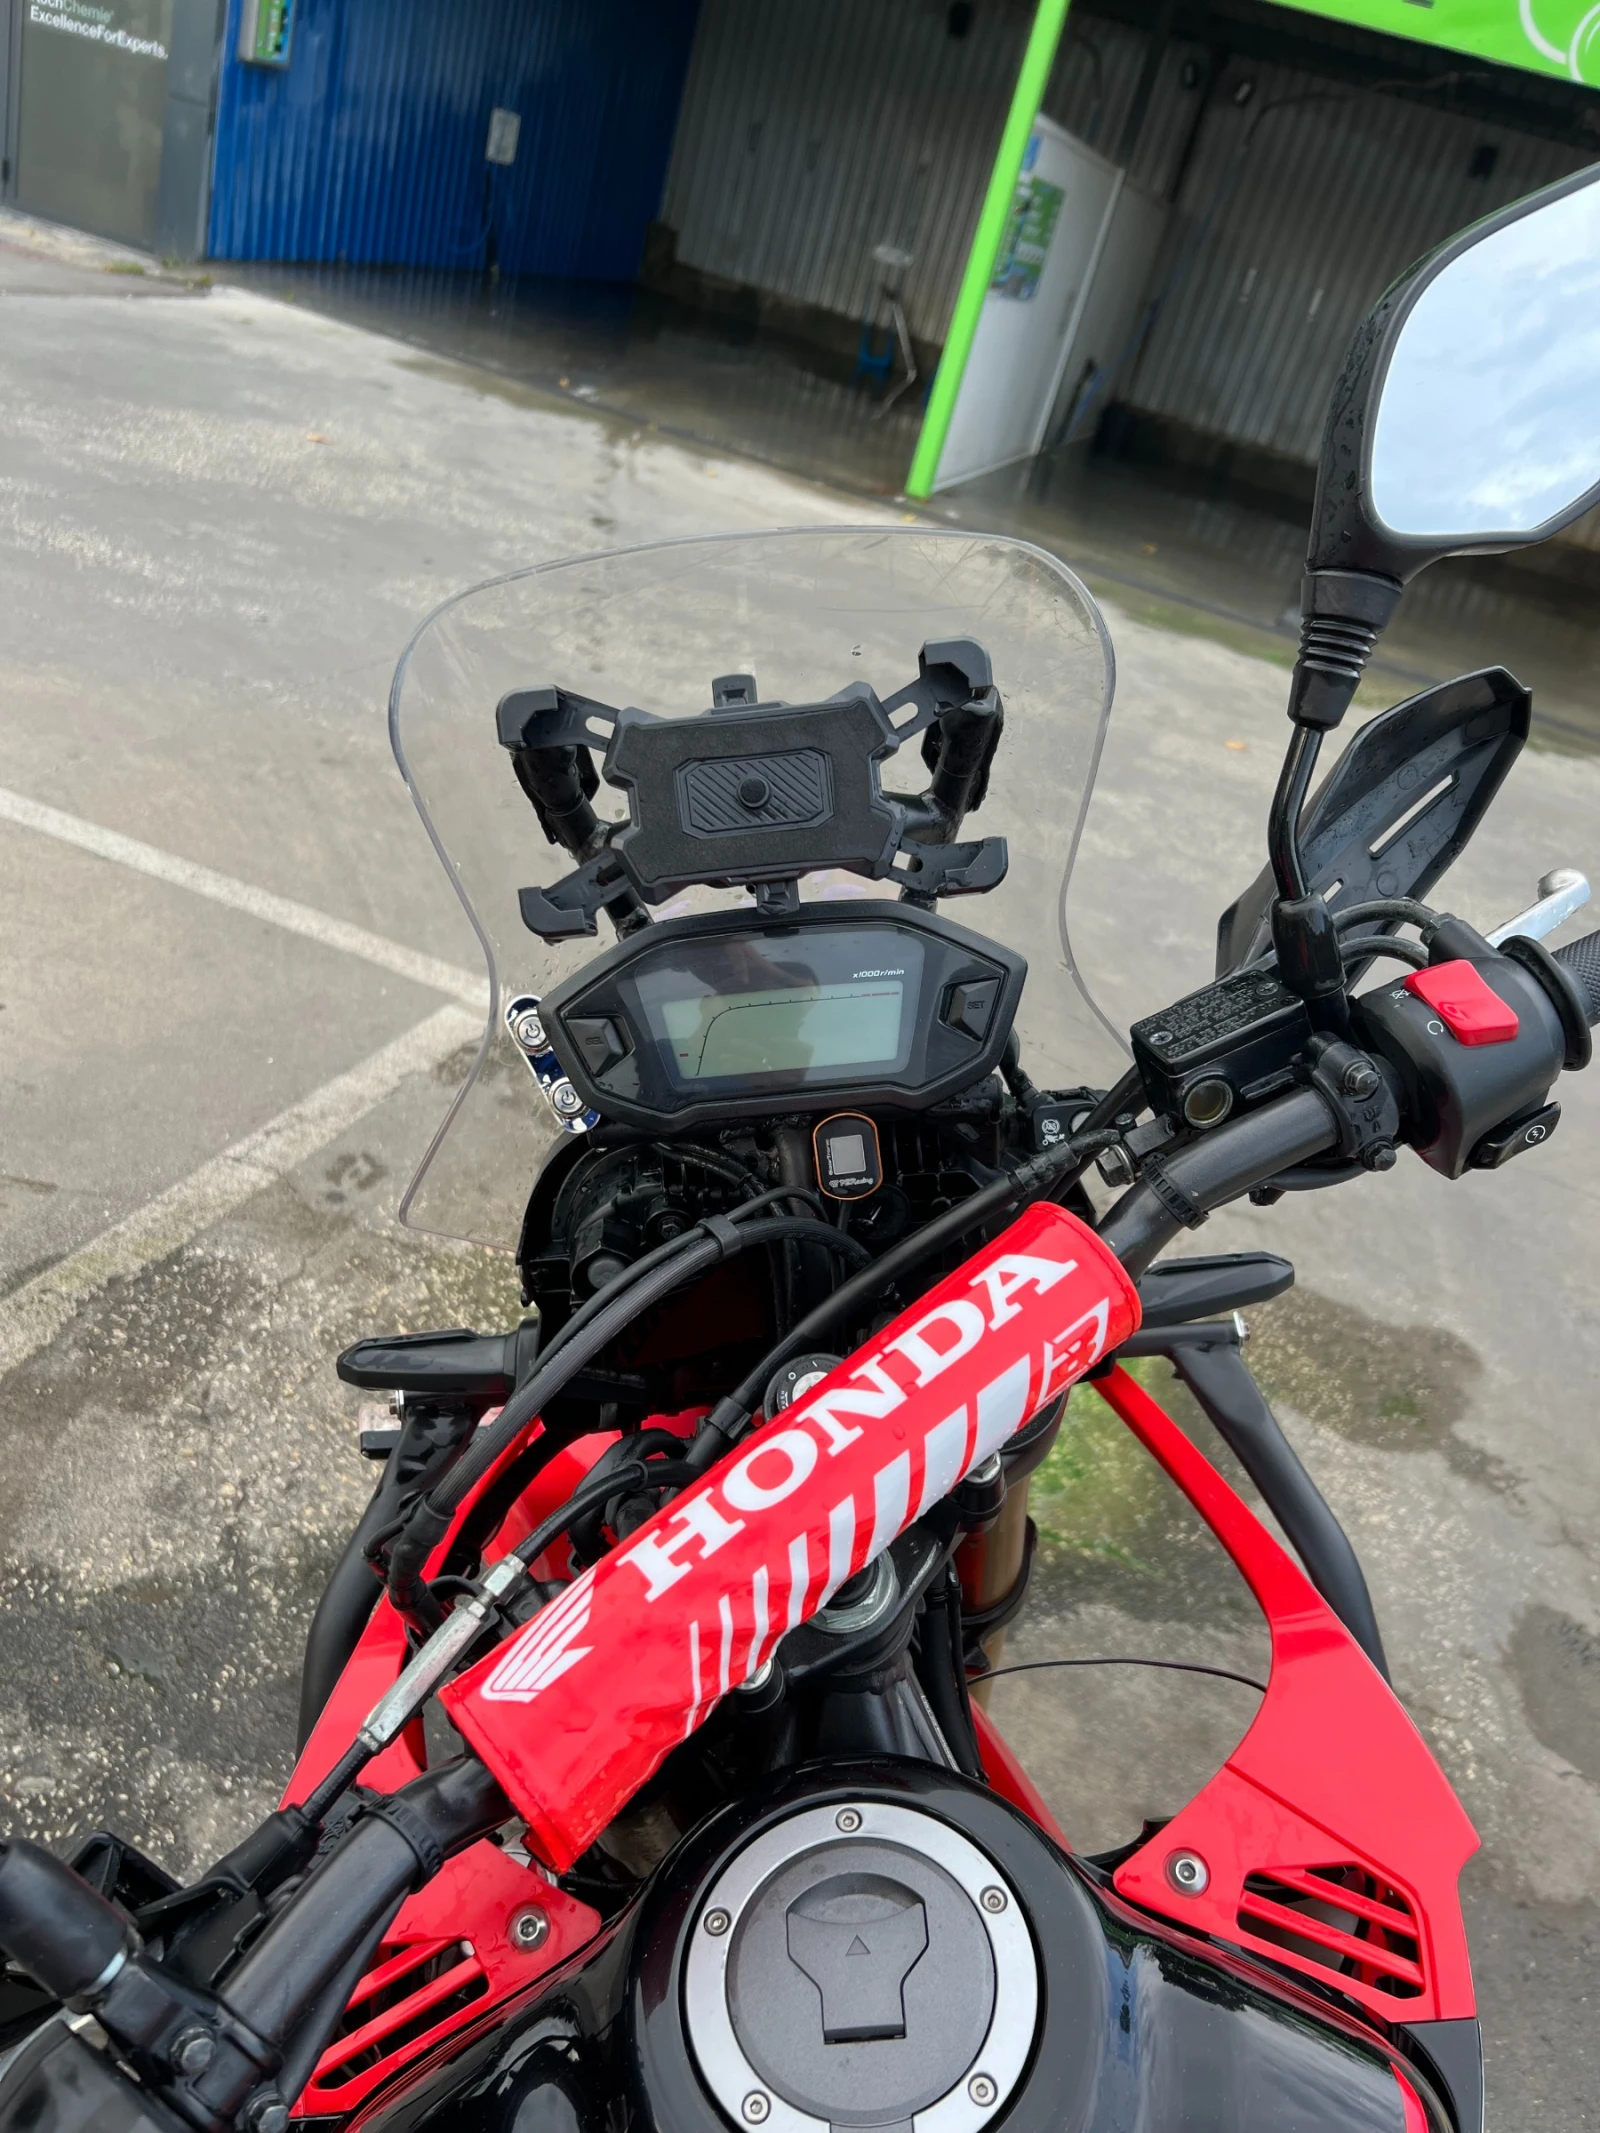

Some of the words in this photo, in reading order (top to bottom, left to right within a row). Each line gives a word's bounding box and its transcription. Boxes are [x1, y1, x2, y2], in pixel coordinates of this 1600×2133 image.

[30, 5, 169, 60] ExcellenceForExperts.
[967, 1000, 986, 1010] SET
[615, 1254, 1079, 1603] HONDA
